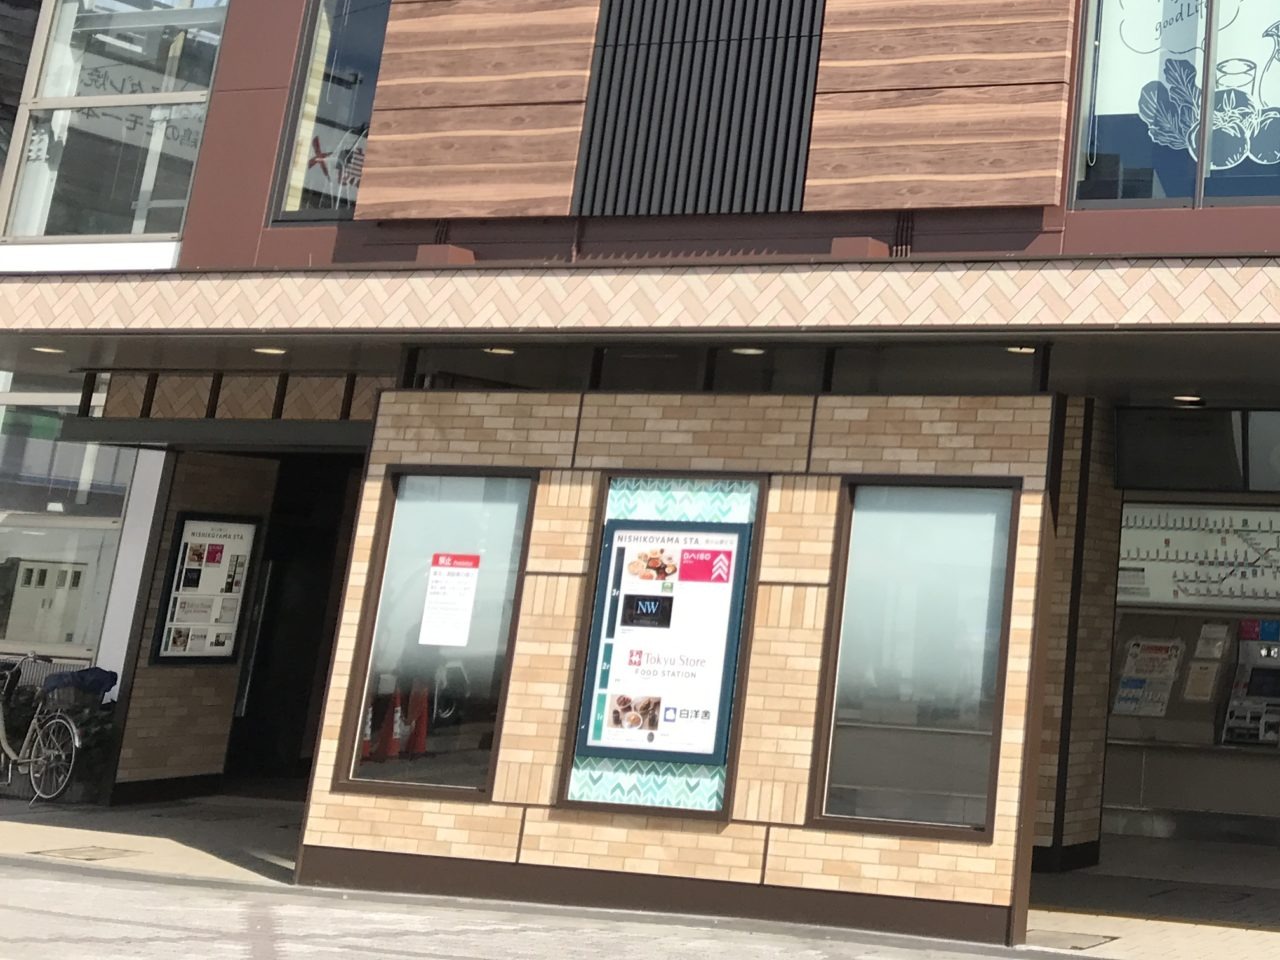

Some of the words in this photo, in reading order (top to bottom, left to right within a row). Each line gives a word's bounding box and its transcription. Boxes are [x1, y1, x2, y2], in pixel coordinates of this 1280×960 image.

[617, 535, 680, 544] NISHIKOYAMA
[684, 537, 699, 545] STA
[645, 652, 676, 666] Tokyu
[679, 654, 707, 668] Store
[661, 670, 697, 679] STATION
